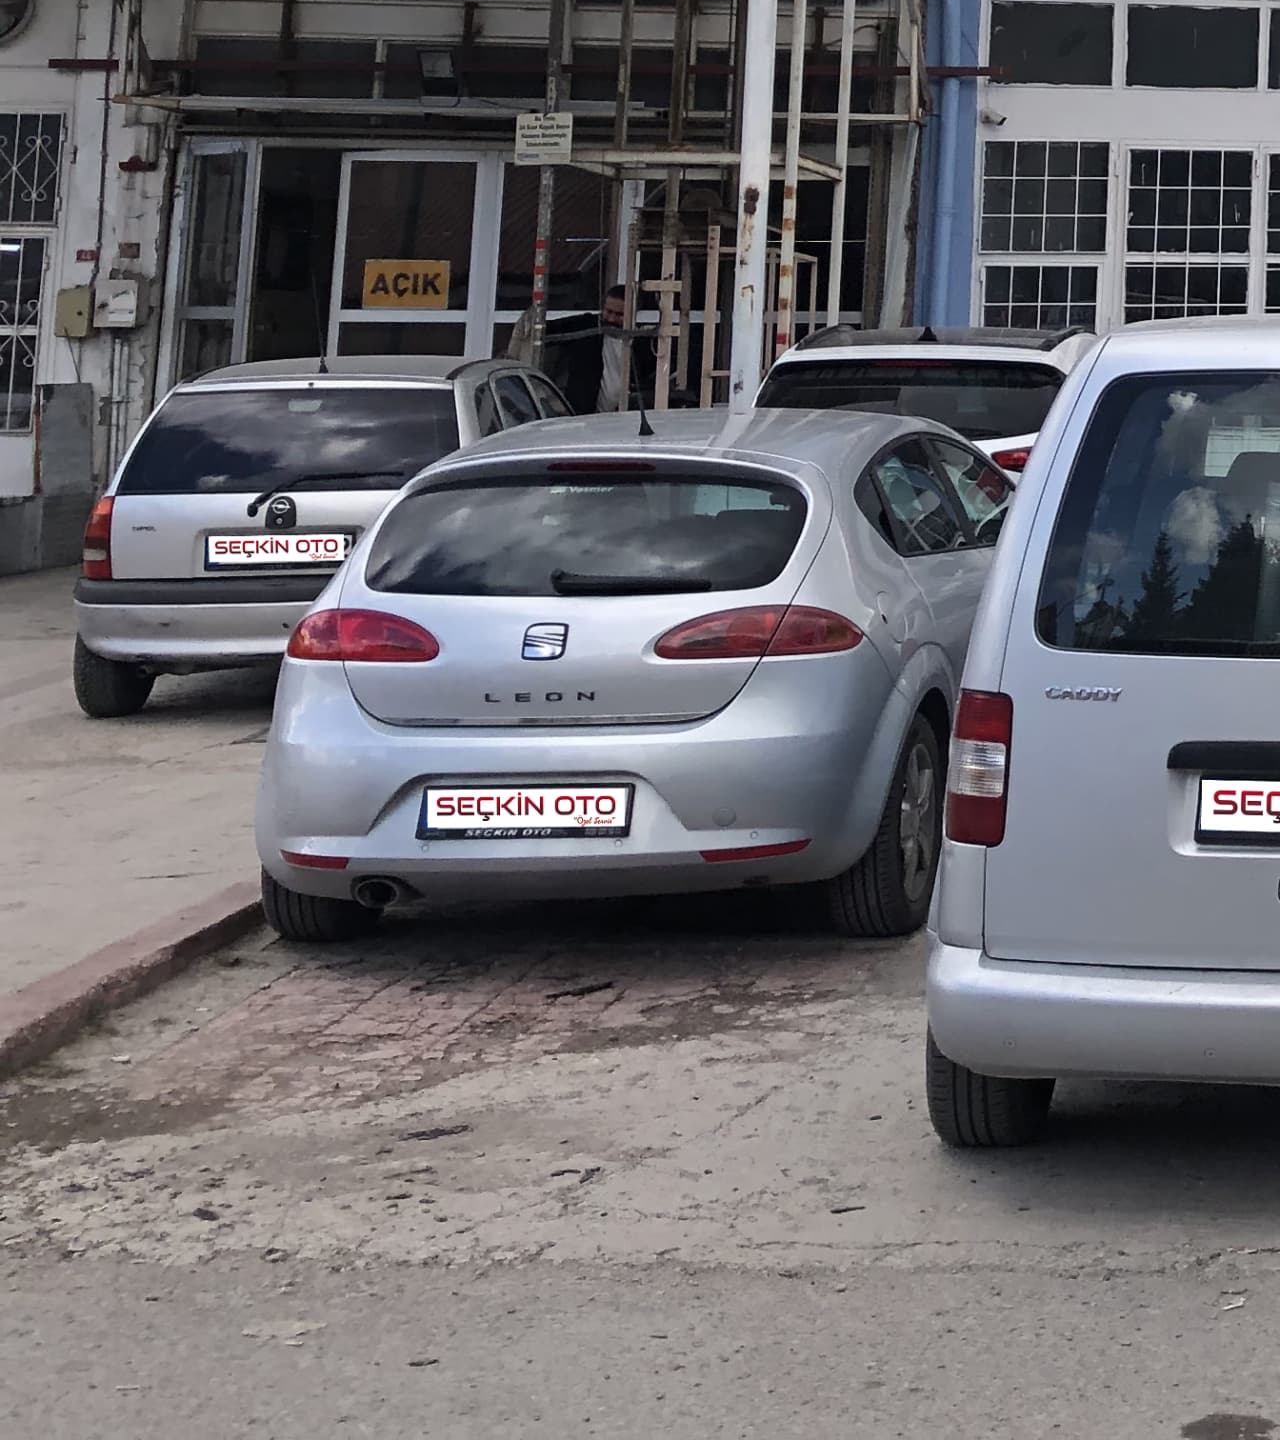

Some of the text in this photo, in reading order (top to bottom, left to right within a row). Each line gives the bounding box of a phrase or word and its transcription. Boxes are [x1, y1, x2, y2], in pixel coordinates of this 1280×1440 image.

[370, 272, 441, 298] AÇIK
[484, 691, 596, 703] LEON
[1045, 687, 1124, 703] CADDY
